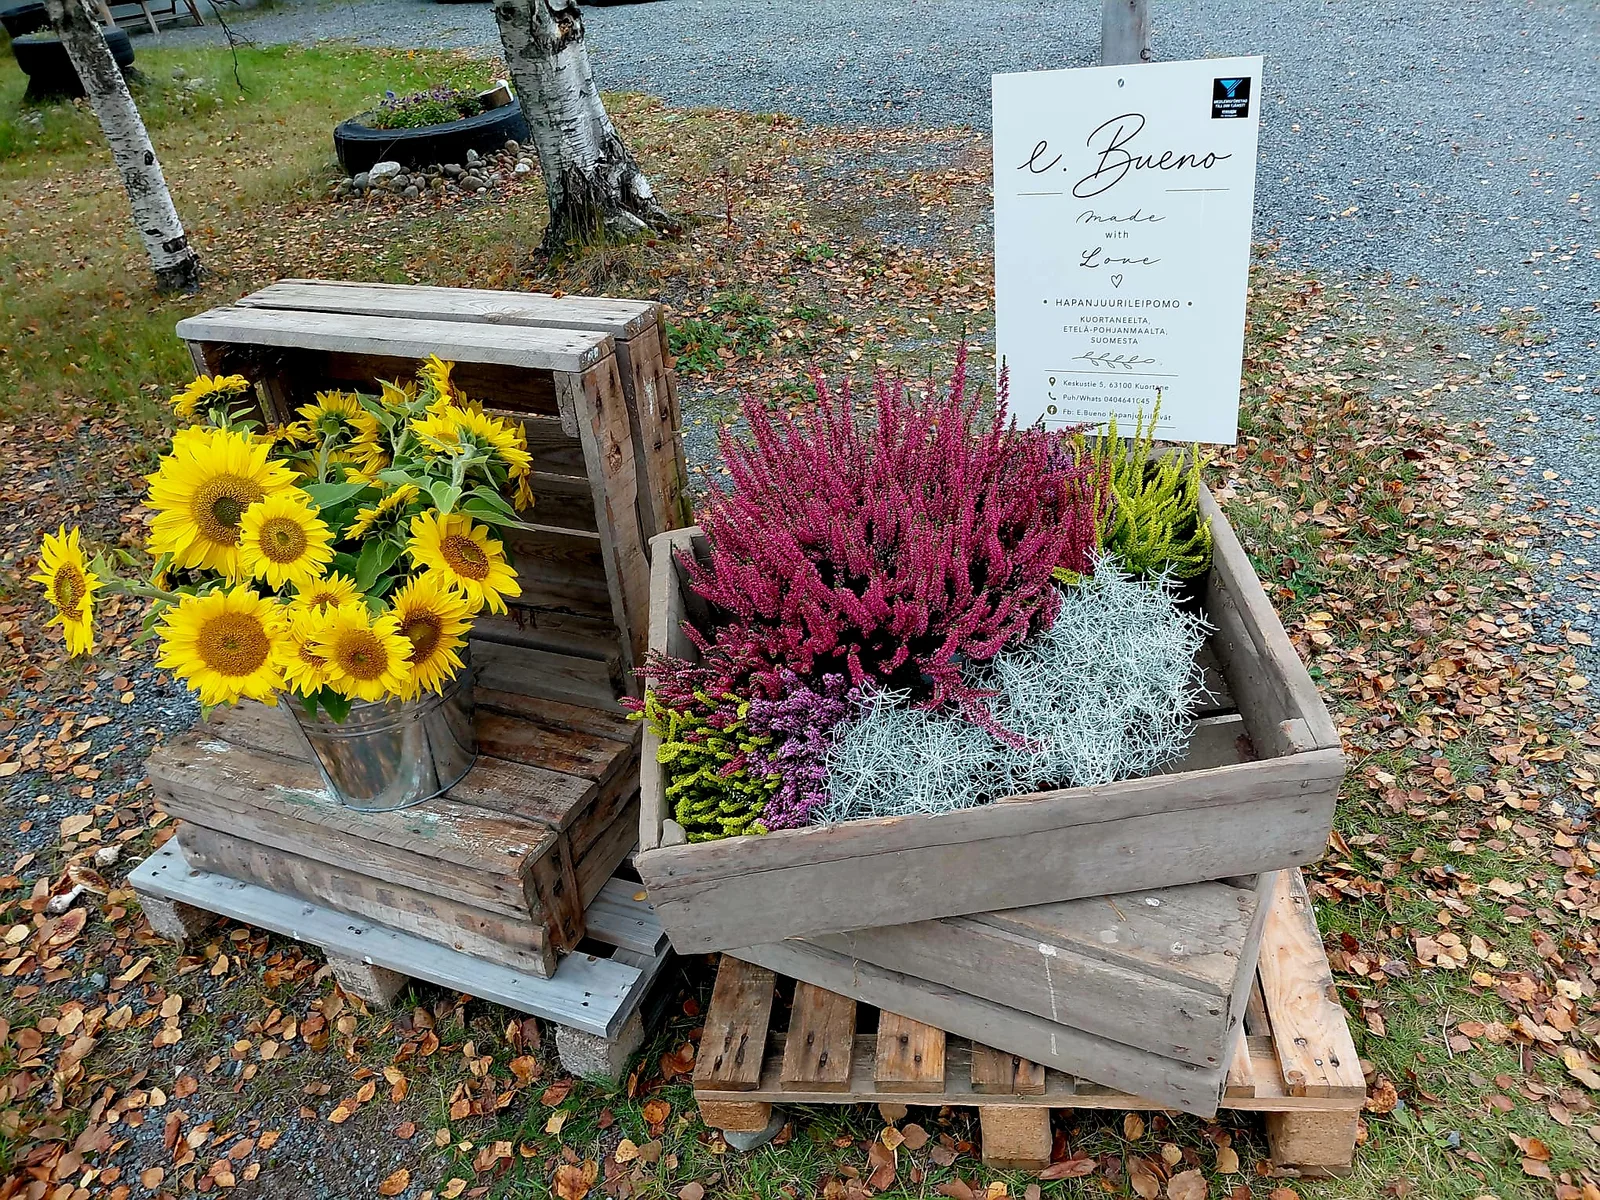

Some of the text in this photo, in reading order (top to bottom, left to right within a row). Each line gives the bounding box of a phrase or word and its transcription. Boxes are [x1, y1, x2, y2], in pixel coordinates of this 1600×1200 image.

[1017, 113, 1232, 198] e. Bueno
[1075, 208, 1166, 223] made
[1105, 230, 1129, 239] with
[1079, 247, 1161, 268] Love
[1055, 298, 1181, 309] HAPANJUURILEIPOMO
[1080, 316, 1151, 325] KUORTANEELTA,
[1063, 325, 1168, 336] ETELÄ-POHJANMAALTA,
[1090, 336, 1139, 345] SUOMESTA
[1063, 394, 1101, 402] Puh/Whats
[1077, 410, 1106, 418] E.Bueno
